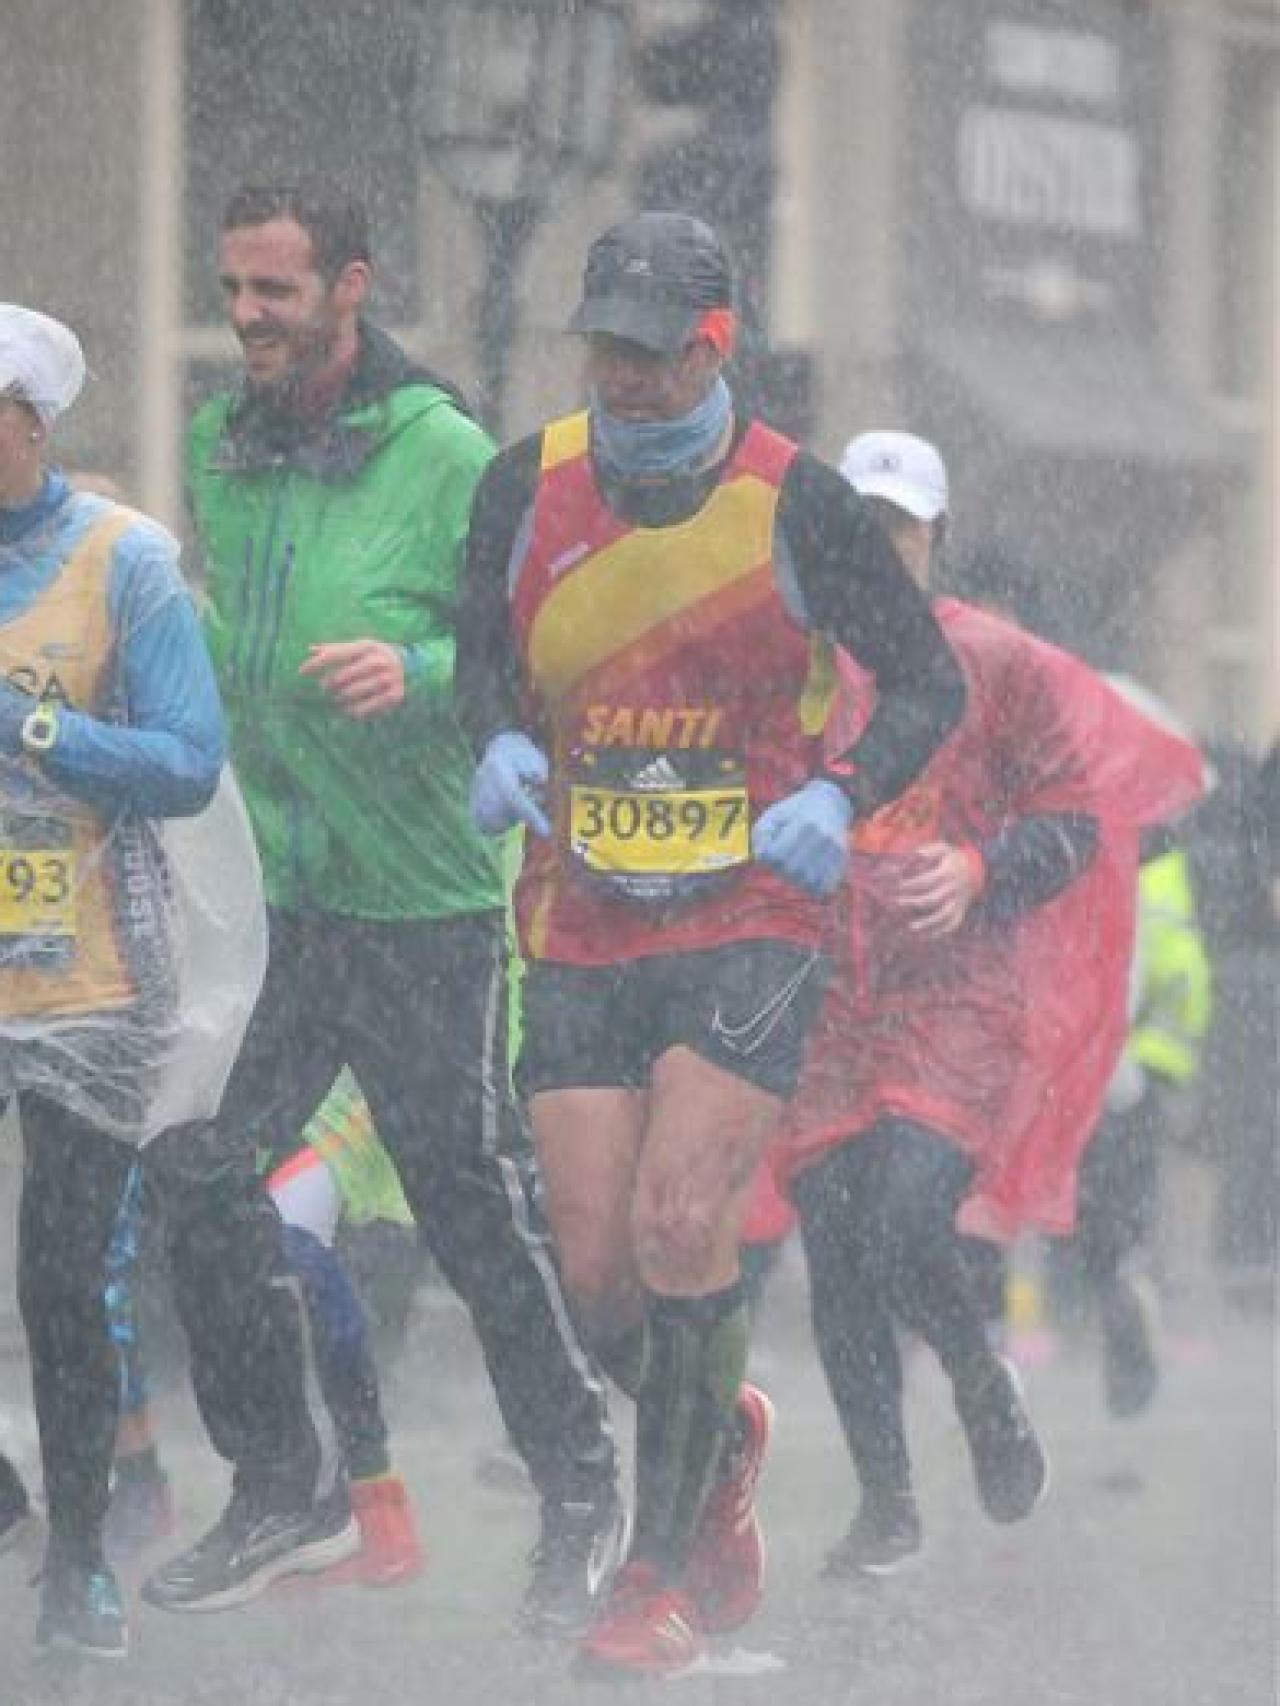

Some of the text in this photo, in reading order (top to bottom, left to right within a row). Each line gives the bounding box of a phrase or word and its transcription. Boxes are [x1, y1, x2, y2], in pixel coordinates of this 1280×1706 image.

[582, 708, 722, 747] SANTI
[580, 798, 744, 840] 30897
[0, 858, 70, 903] 93
